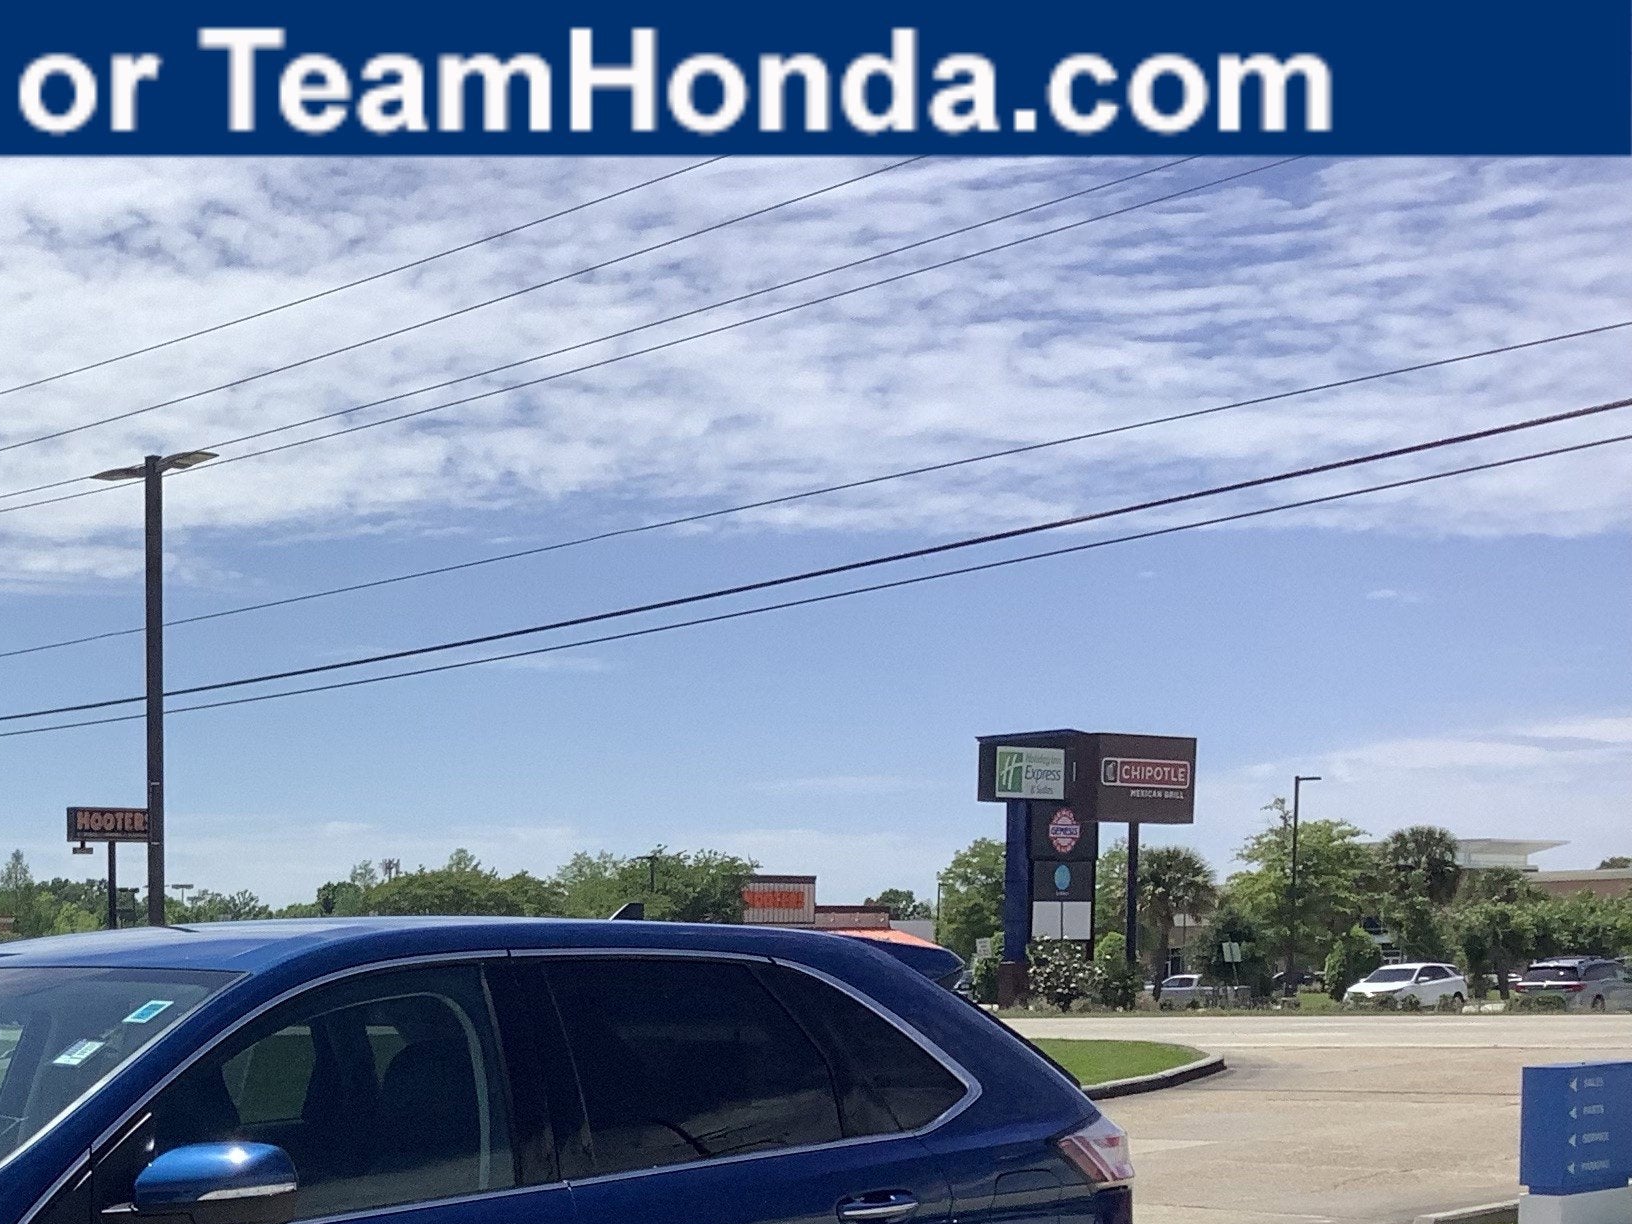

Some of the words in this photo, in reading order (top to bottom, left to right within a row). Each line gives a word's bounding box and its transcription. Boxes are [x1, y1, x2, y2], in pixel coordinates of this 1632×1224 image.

[1025, 765, 1061, 783] Express
[1121, 765, 1186, 782] CHIPOTLE
[1130, 789, 1163, 798] MEXICAN
